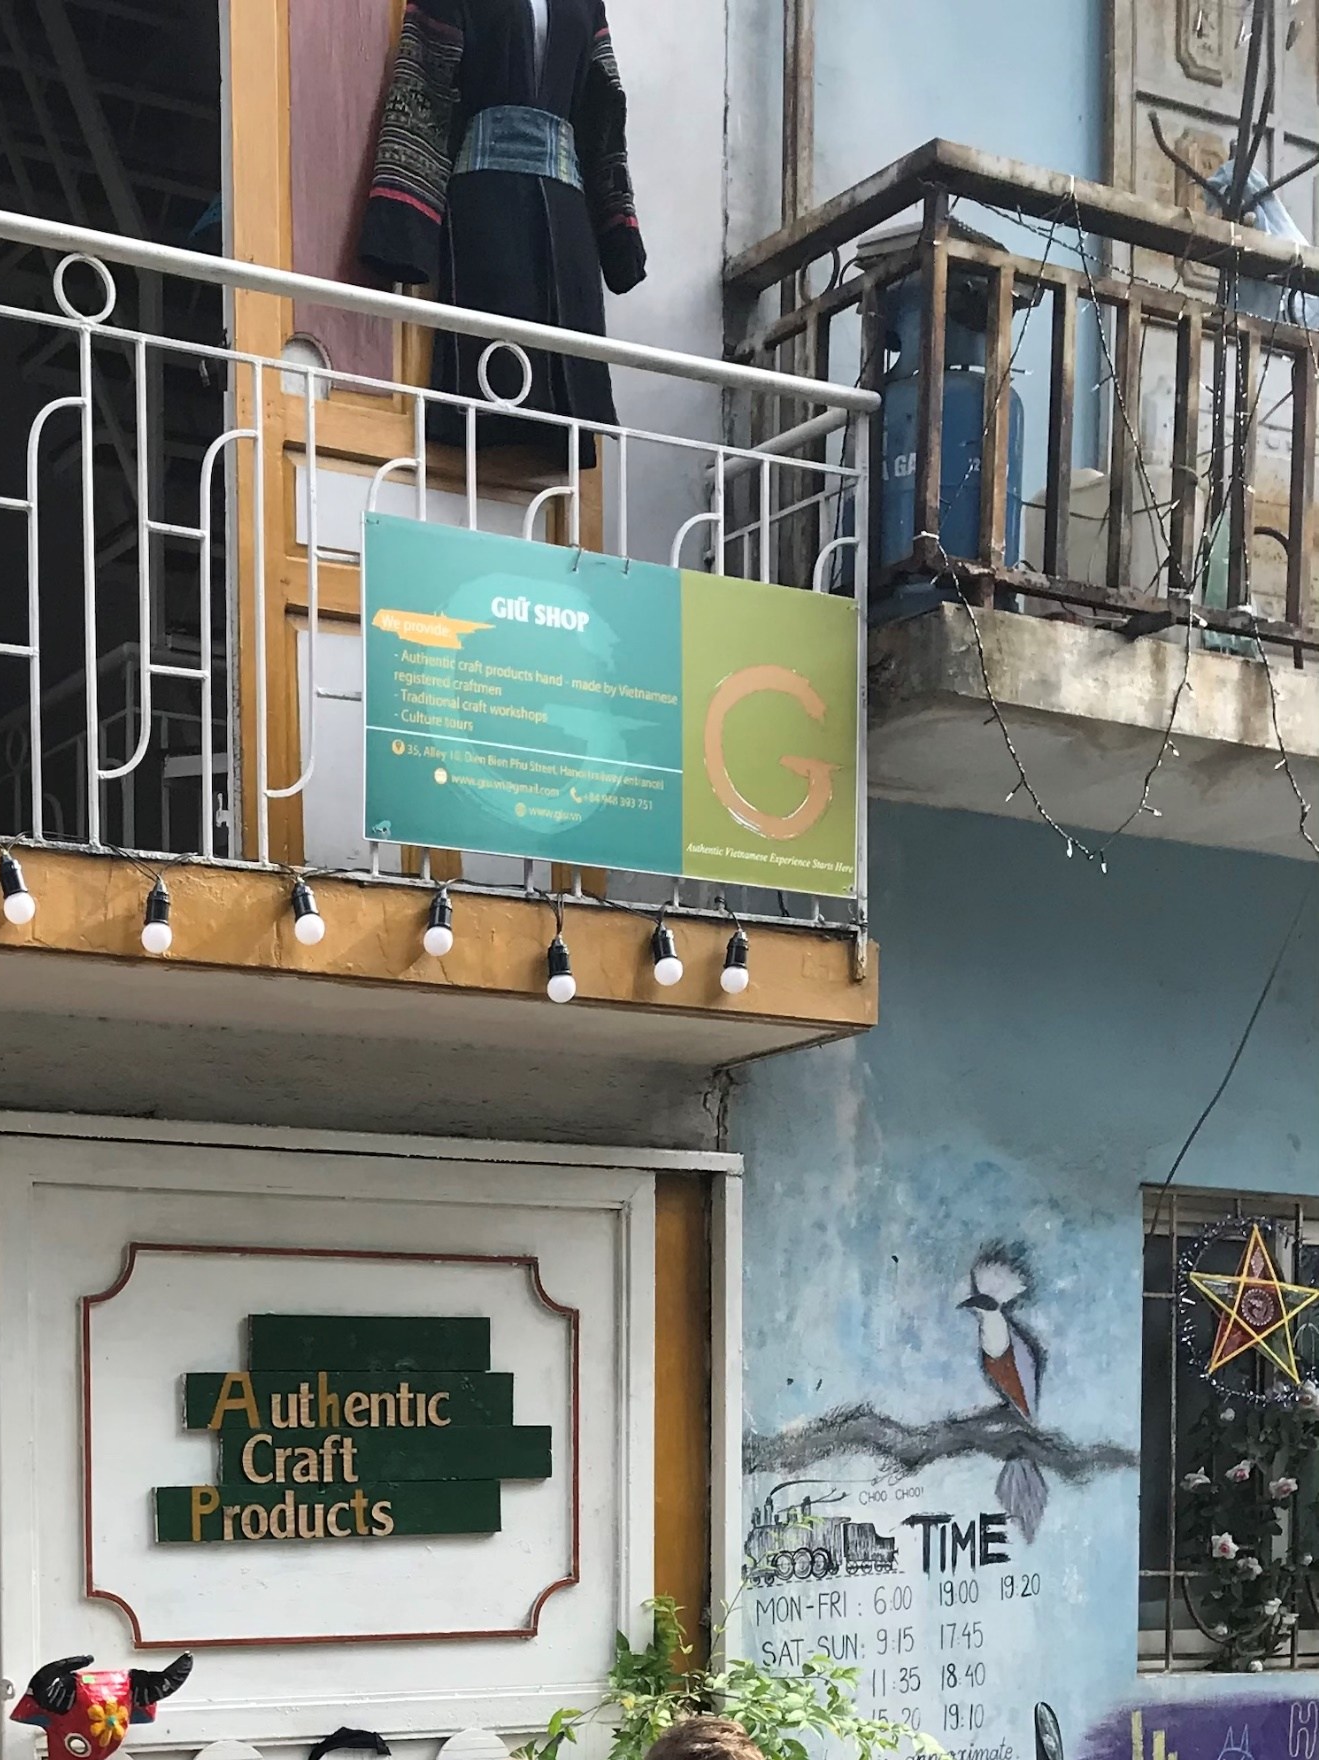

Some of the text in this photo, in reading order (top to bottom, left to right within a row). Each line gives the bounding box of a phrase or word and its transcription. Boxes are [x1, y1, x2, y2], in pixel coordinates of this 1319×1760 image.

[382, 614, 401, 629] We
[491, 596, 589, 632] GIỮ SHOP
[394, 671, 501, 696] registered craftmen
[401, 649, 455, 669] Authentic
[458, 660, 482, 674] craft
[485, 664, 532, 682] products
[535, 670, 562, 686] hand
[572, 678, 601, 693] made
[603, 682, 617, 698] by
[618, 684, 678, 705] Vietnamese
[401, 689, 548, 724] Traditional craft workshops
[401, 709, 473, 731] Culture tours
[510, 758, 528, 770] Phu
[686, 843, 853, 874] Authentic Vietnamese Experience Starts Here
[207, 1371, 451, 1430] Authentic
[242, 1434, 359, 1484] Craft
[191, 1486, 394, 1541] Products
[859, 1490, 887, 1505] CHOO
[902, 1511, 1012, 1574] TIME
[873, 1585, 913, 1615] 6:00
[938, 1579, 979, 1607] 19:00
[1000, 1573, 1041, 1600] 19:20
[876, 1627, 914, 1655] 9:15
[940, 1621, 984, 1651] 17:45
[872, 1661, 985, 1697] 11:35 18:40
[943, 1703, 984, 1732] 19:10
